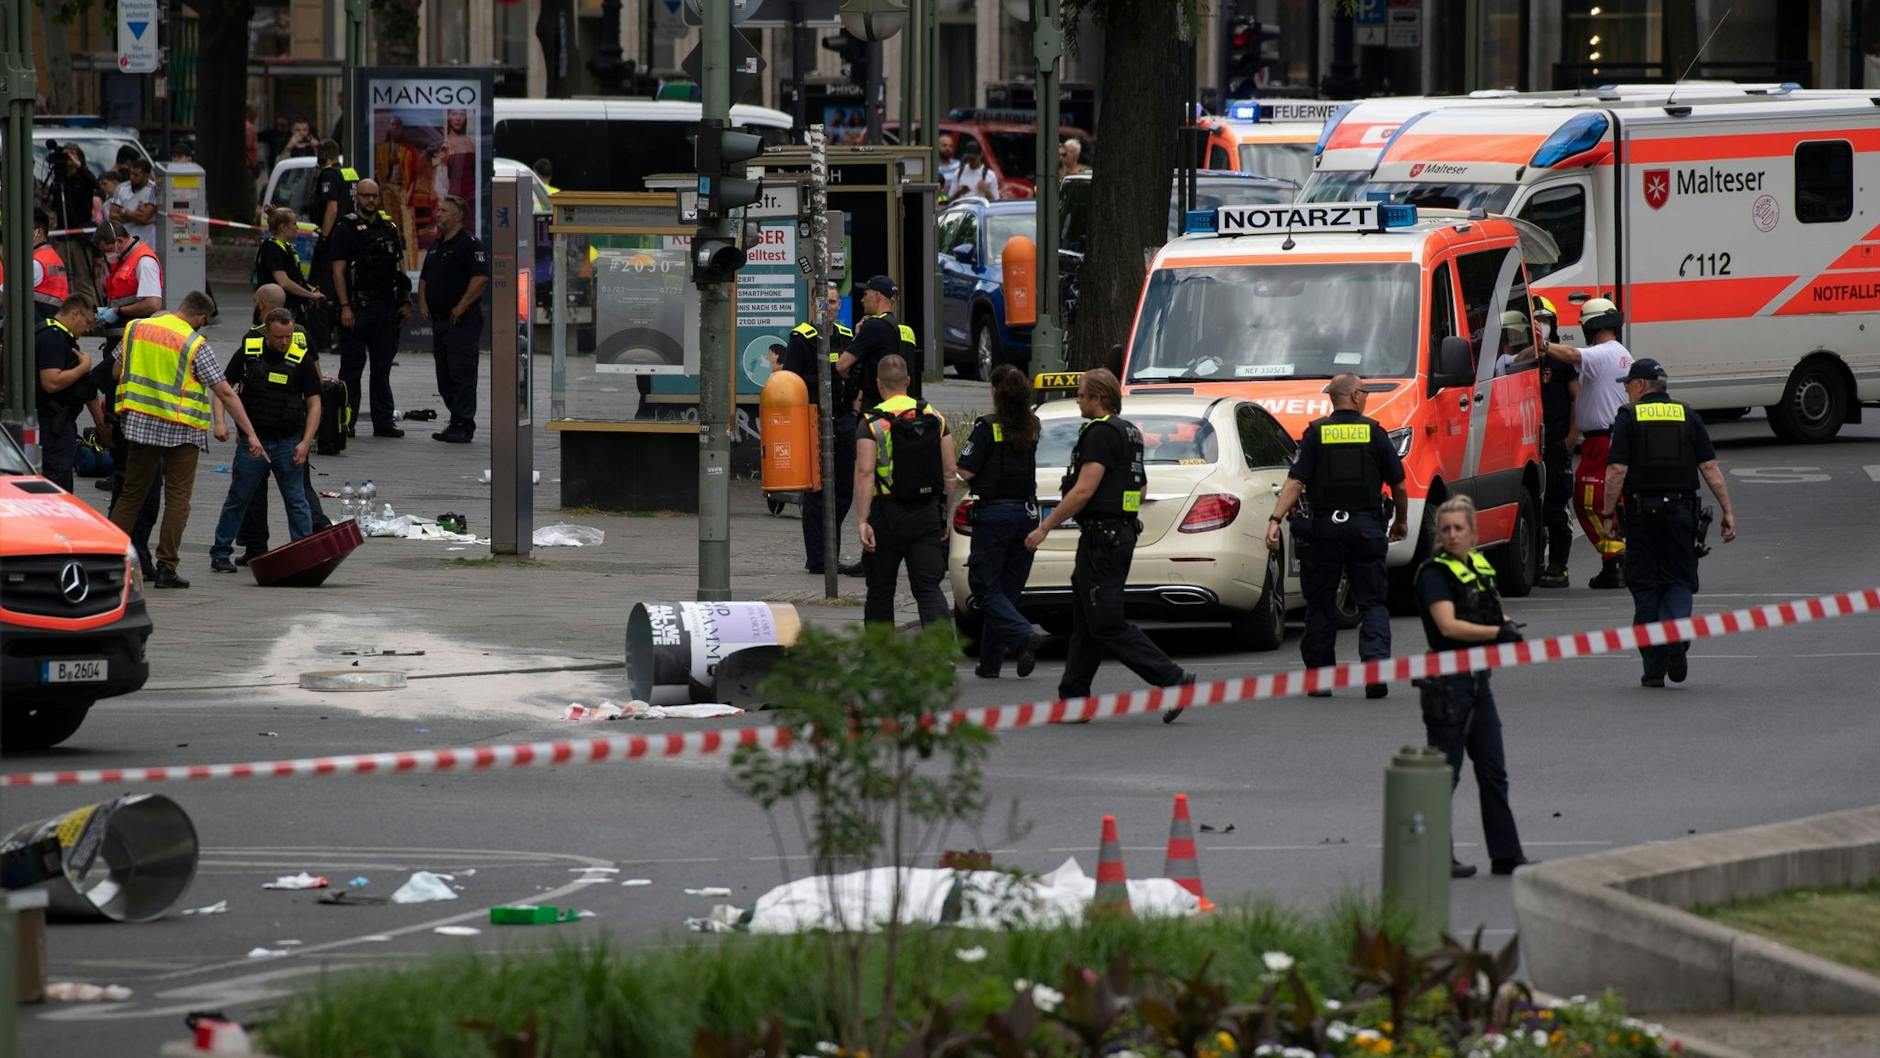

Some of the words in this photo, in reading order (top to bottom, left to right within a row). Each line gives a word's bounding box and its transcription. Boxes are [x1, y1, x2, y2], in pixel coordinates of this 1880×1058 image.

[373, 86, 476, 105] MANGO
[1274, 105, 1339, 118] FEUERWE
[1424, 163, 1468, 175] Malteser
[1677, 166, 1765, 195] Malteser
[1224, 207, 1372, 229] NOTARZT
[748, 249, 786, 261] elltest
[1697, 252, 1731, 276] 112
[1640, 405, 1683, 418] POLIZEI
[1324, 427, 1368, 441] POLIZEI
[58, 663, 66, 679] B
[74, 662, 100, 679] 2604
